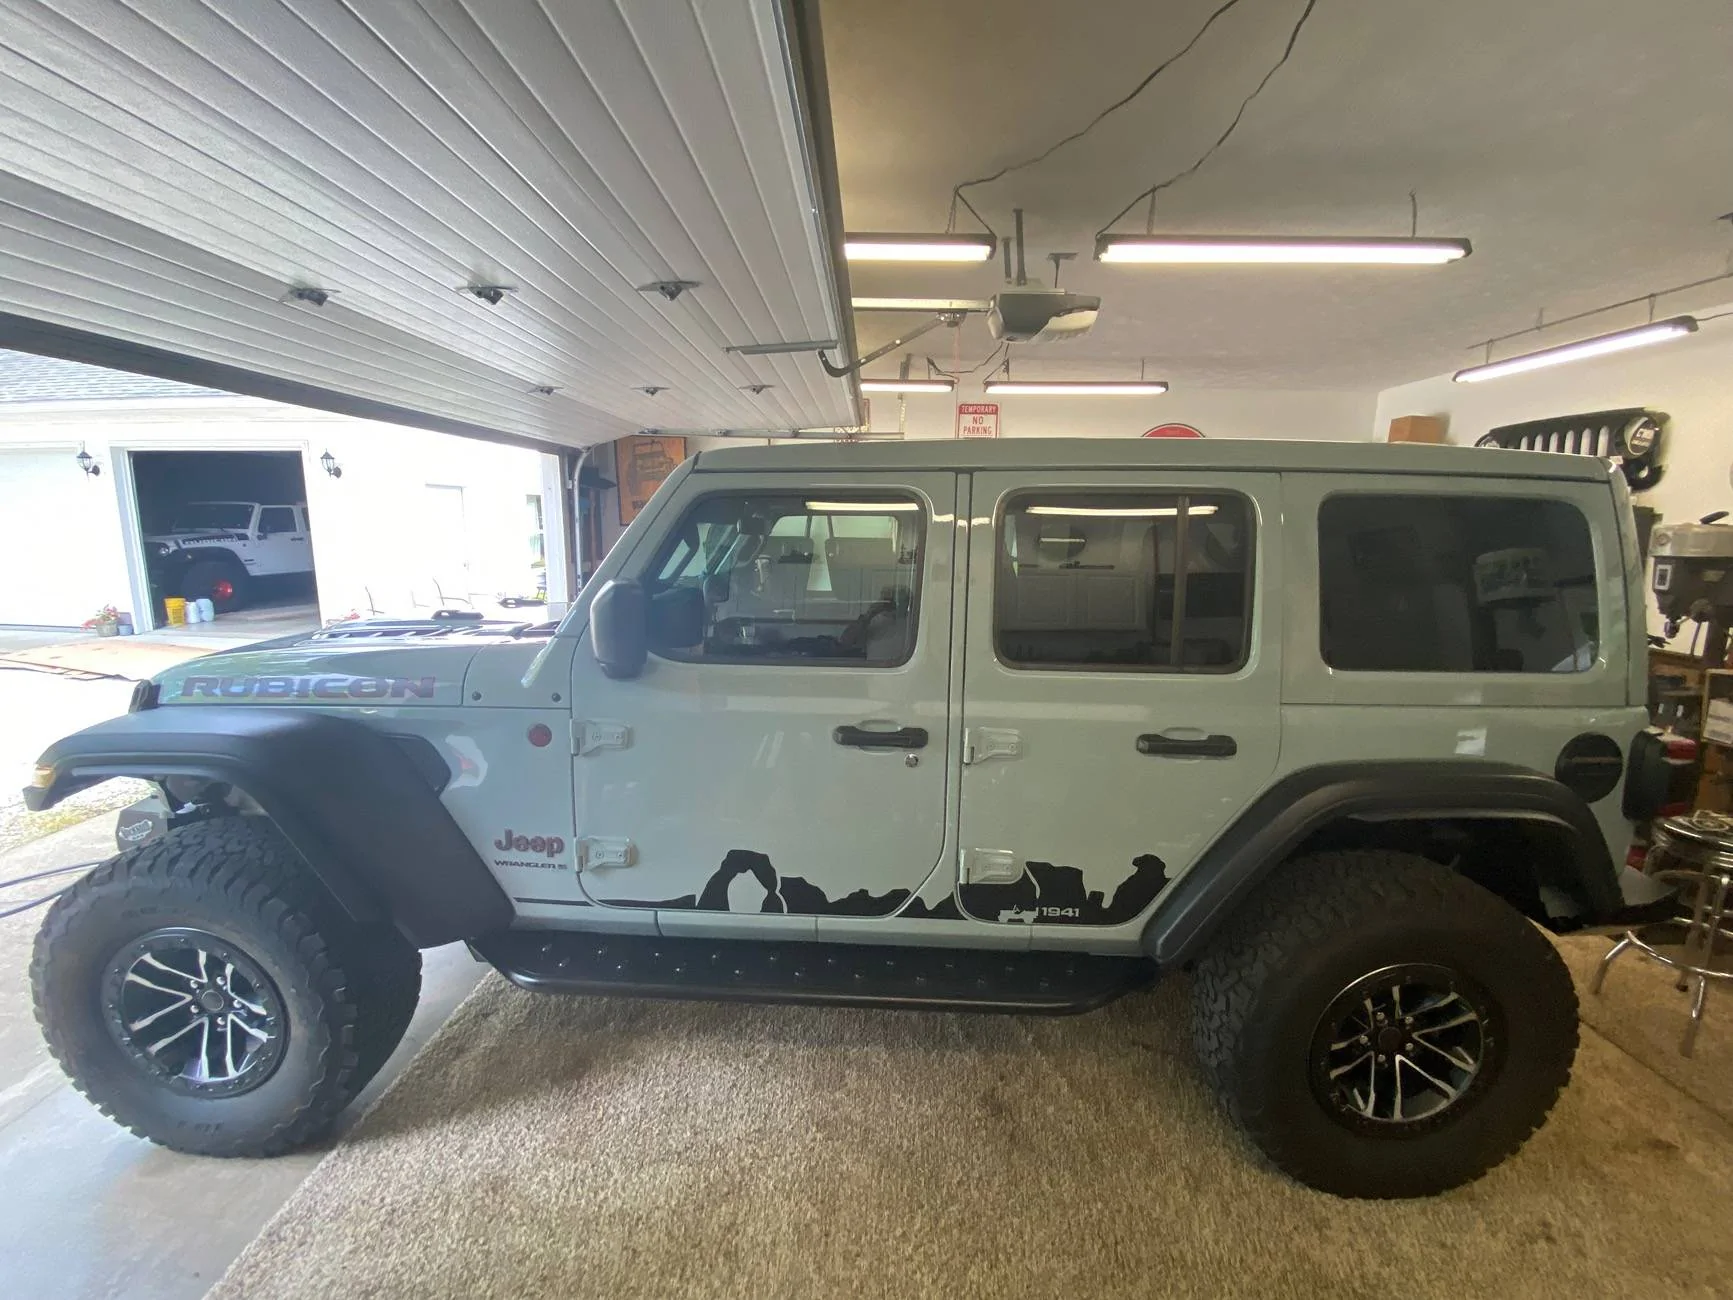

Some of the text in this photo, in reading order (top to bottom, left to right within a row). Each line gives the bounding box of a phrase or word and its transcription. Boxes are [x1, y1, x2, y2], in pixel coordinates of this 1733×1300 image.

[961, 405, 997, 413] TEMPORARY
[972, 416, 984, 424] NO
[963, 425, 992, 435] PARKING
[181, 677, 436, 699] RUBICON
[494, 828, 565, 858] Jeep
[494, 860, 557, 870] WRANGLER
[1041, 906, 1080, 918] 1941
